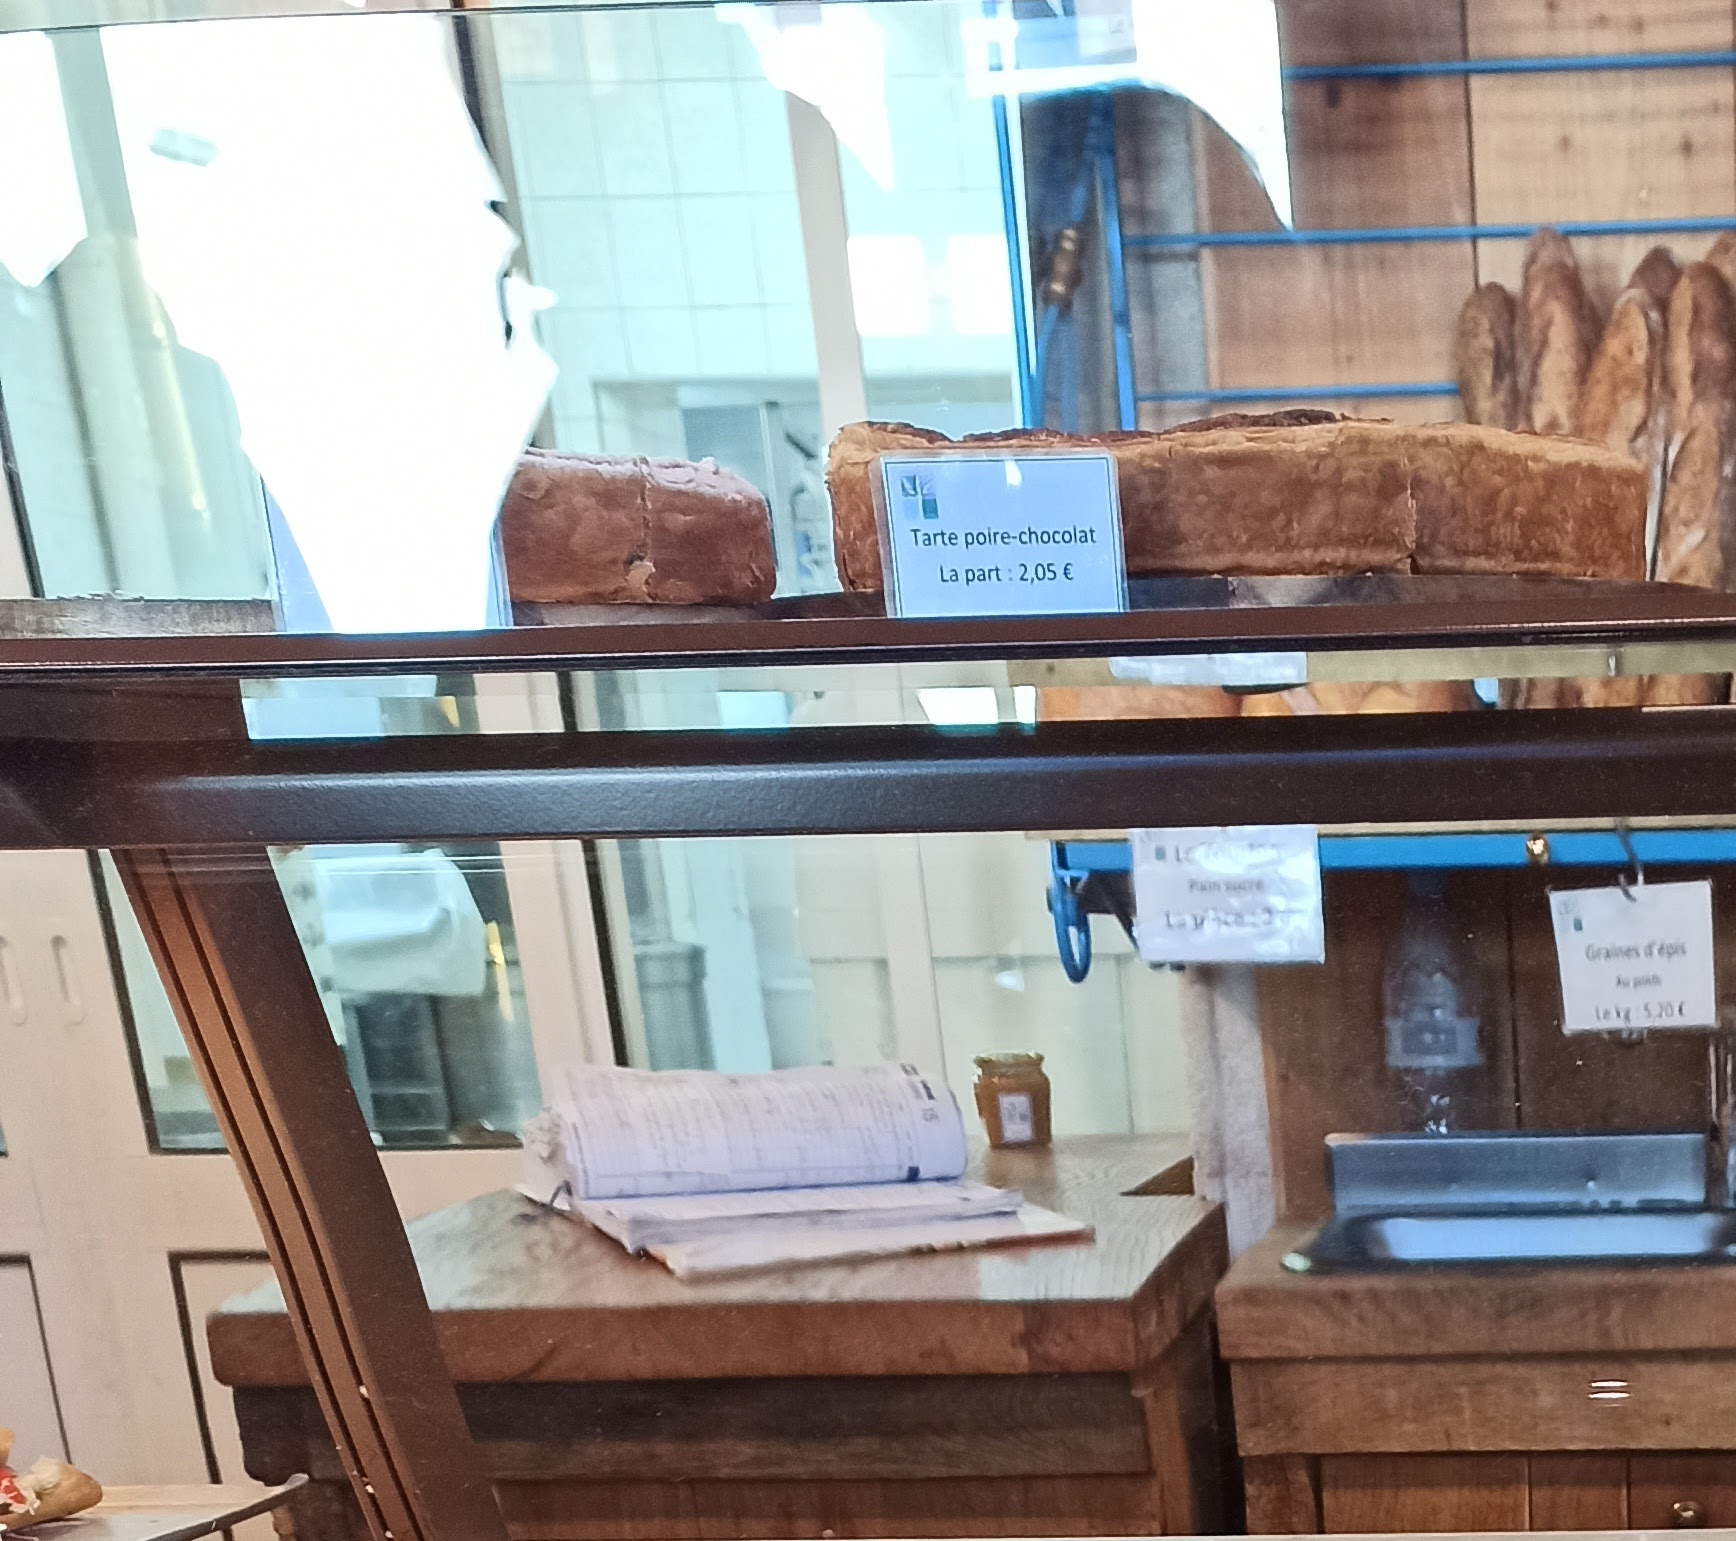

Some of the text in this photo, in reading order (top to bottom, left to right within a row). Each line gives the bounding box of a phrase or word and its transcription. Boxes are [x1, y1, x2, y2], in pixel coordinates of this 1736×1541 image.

[910, 525, 1097, 549] Tarte poire-chocolat
[940, 565, 959, 583] La
[965, 565, 1002, 586] part
[1019, 562, 1057, 584] 2,05
[1063, 562, 1074, 581] €
